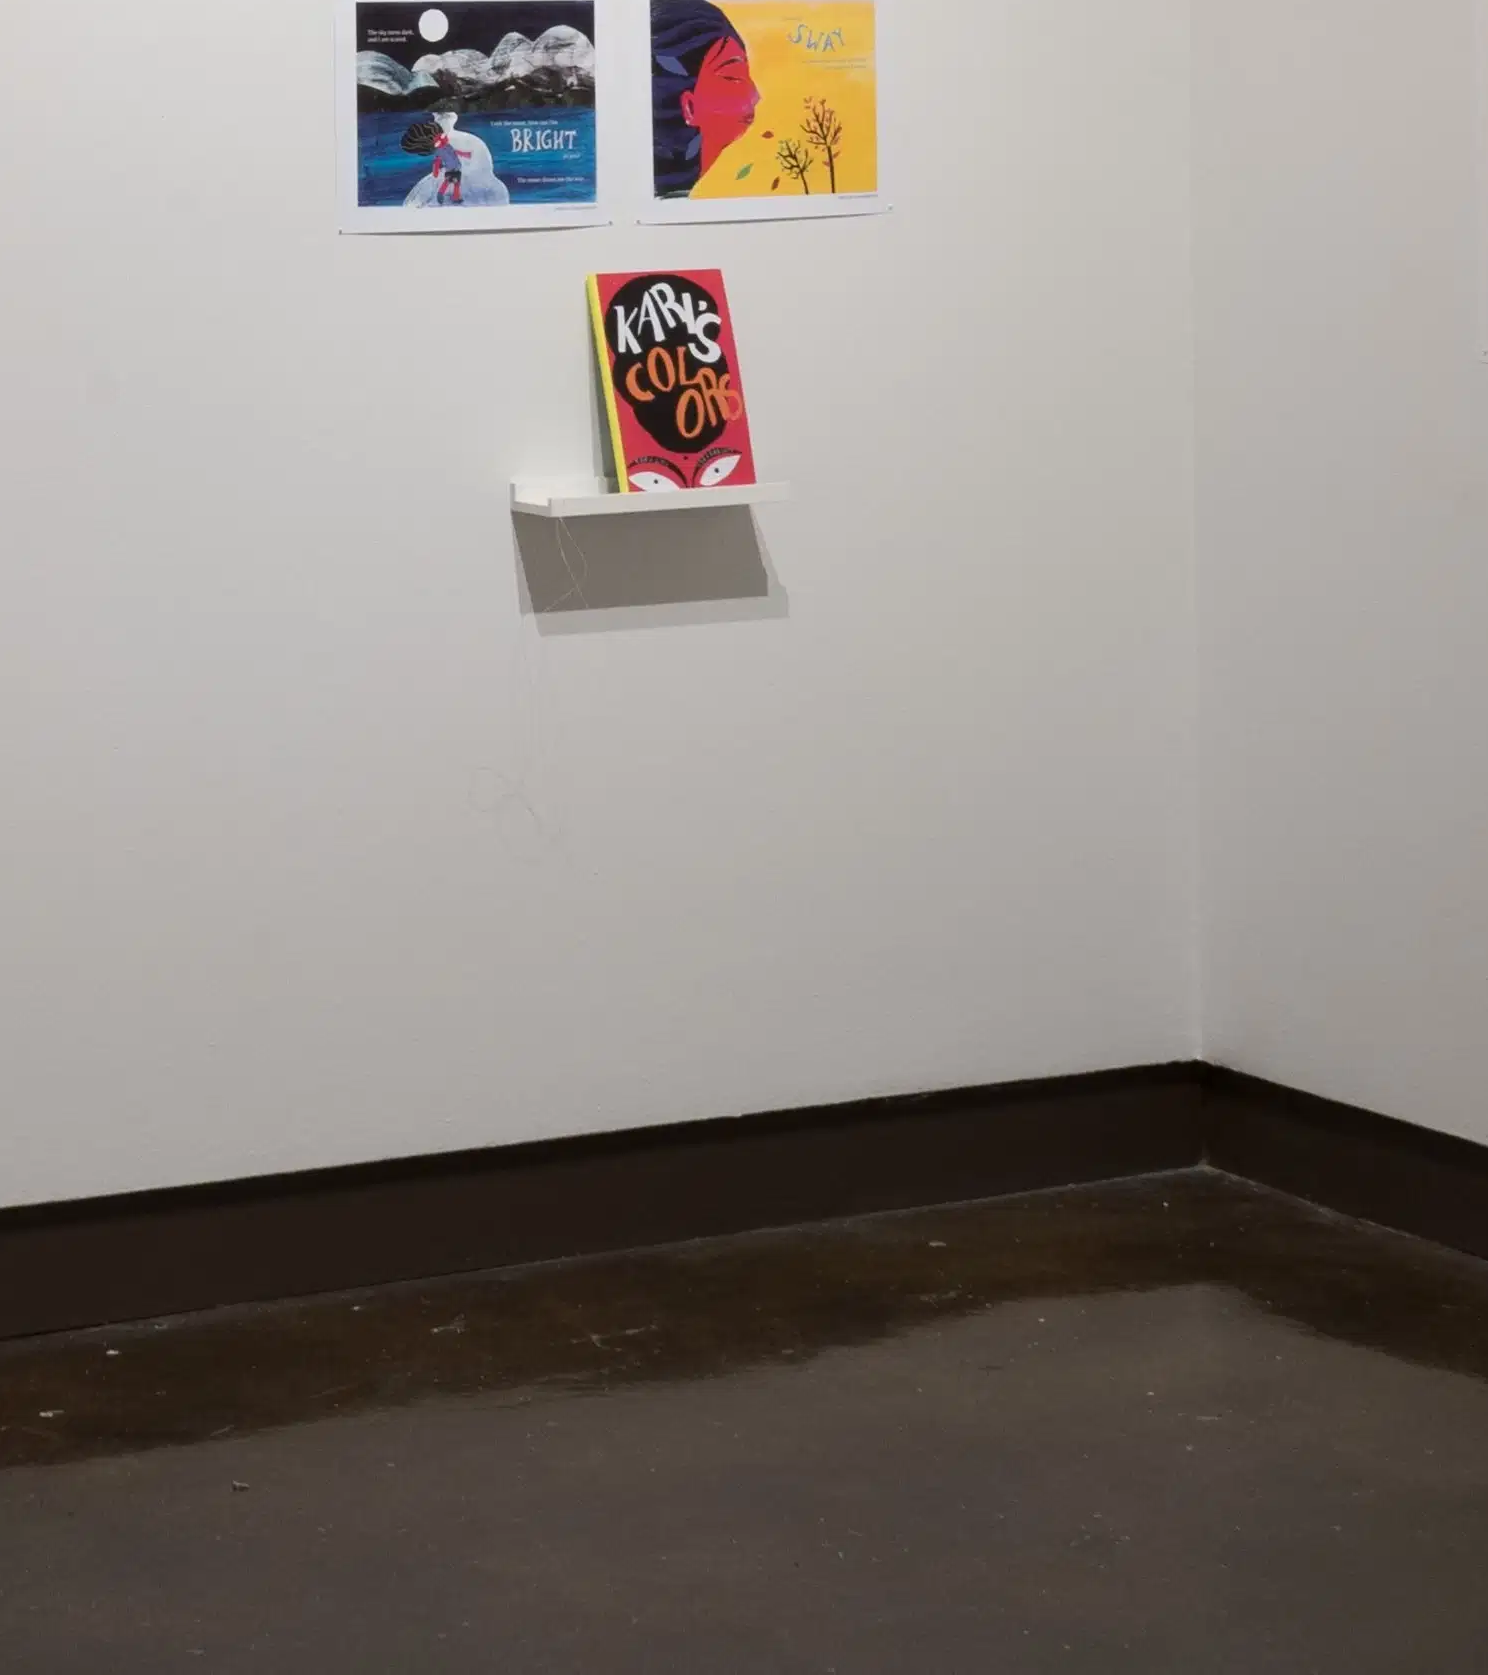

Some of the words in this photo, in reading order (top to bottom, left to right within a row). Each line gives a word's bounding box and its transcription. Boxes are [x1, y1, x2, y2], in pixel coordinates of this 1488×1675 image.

[786, 23, 846, 52] SWAY
[511, 128, 577, 153] BRIGHT
[614, 282, 722, 363] KARI'S
